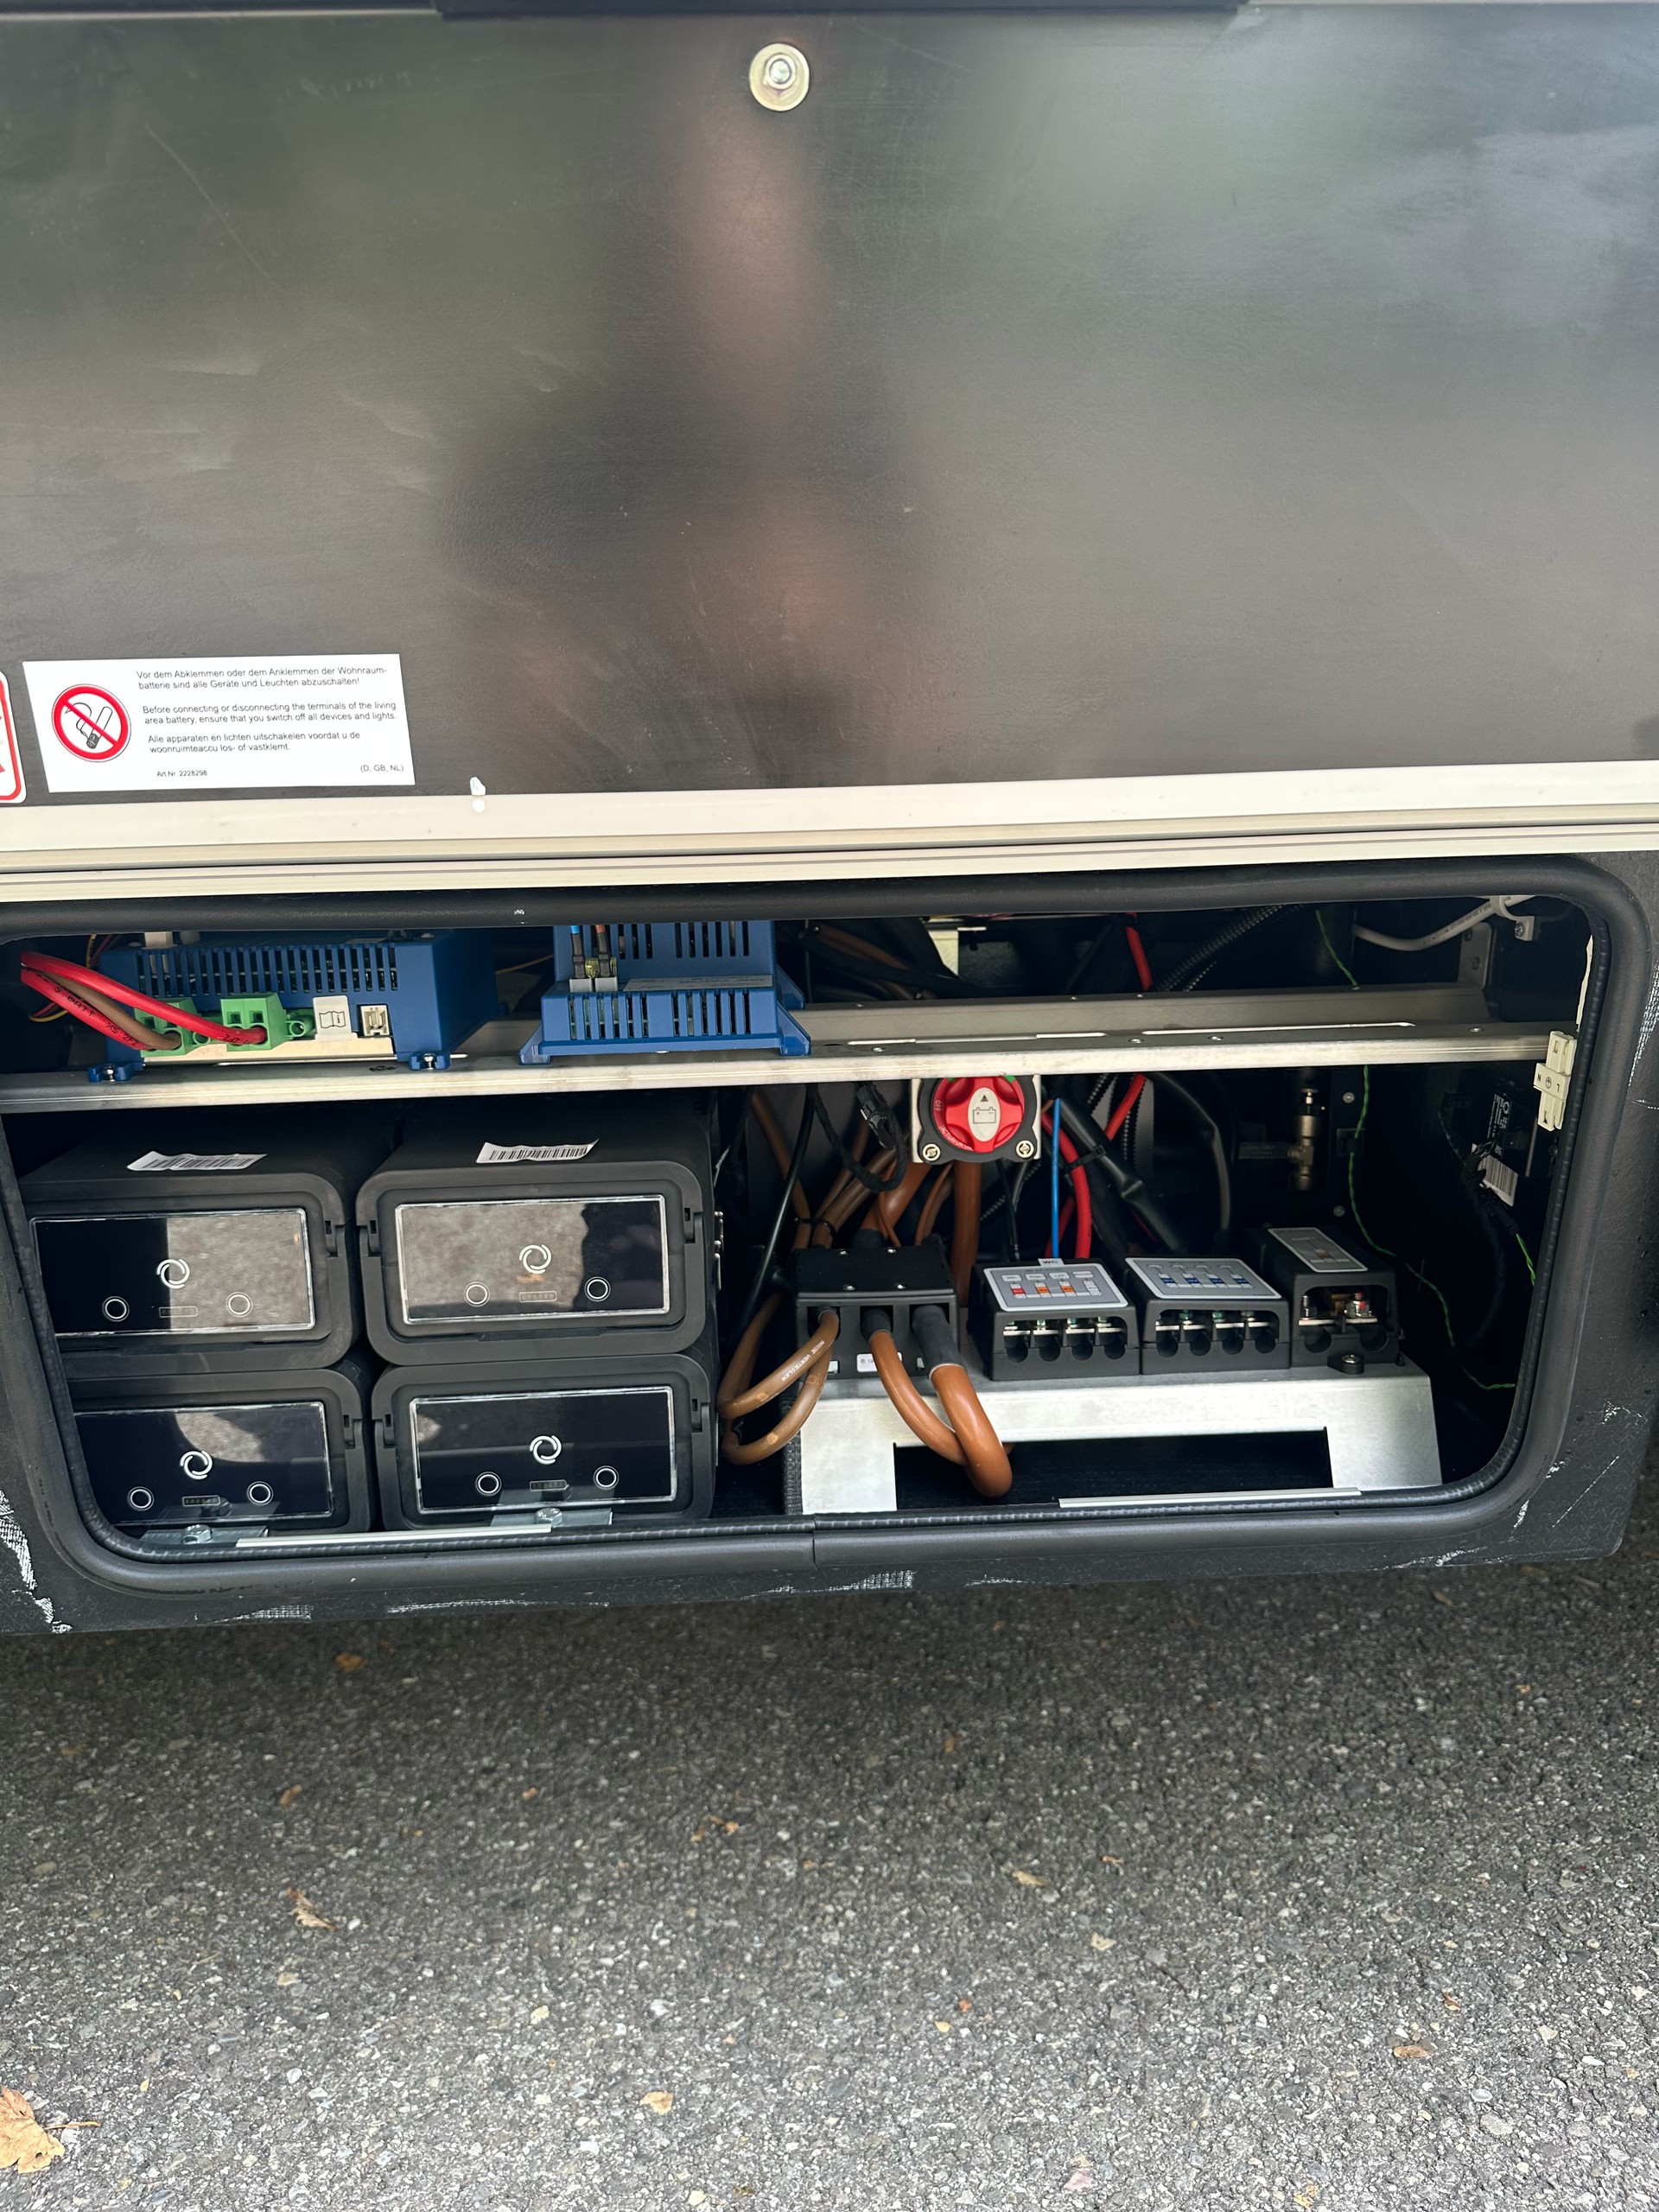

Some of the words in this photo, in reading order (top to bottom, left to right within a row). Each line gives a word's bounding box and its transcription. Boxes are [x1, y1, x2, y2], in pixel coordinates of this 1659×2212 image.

[175, 670, 224, 678] Abklemmen
[302, 677, 359, 686] abzuschalten!
[173, 705, 219, 714] connecting
[375, 702, 396, 710] living
[166, 716, 197, 725] battery,
[372, 712, 397, 721] lights.
[167, 734, 208, 744] apparaten
[254, 732, 306, 741] uitschakelen
[391, 764, 404, 772] NL)
